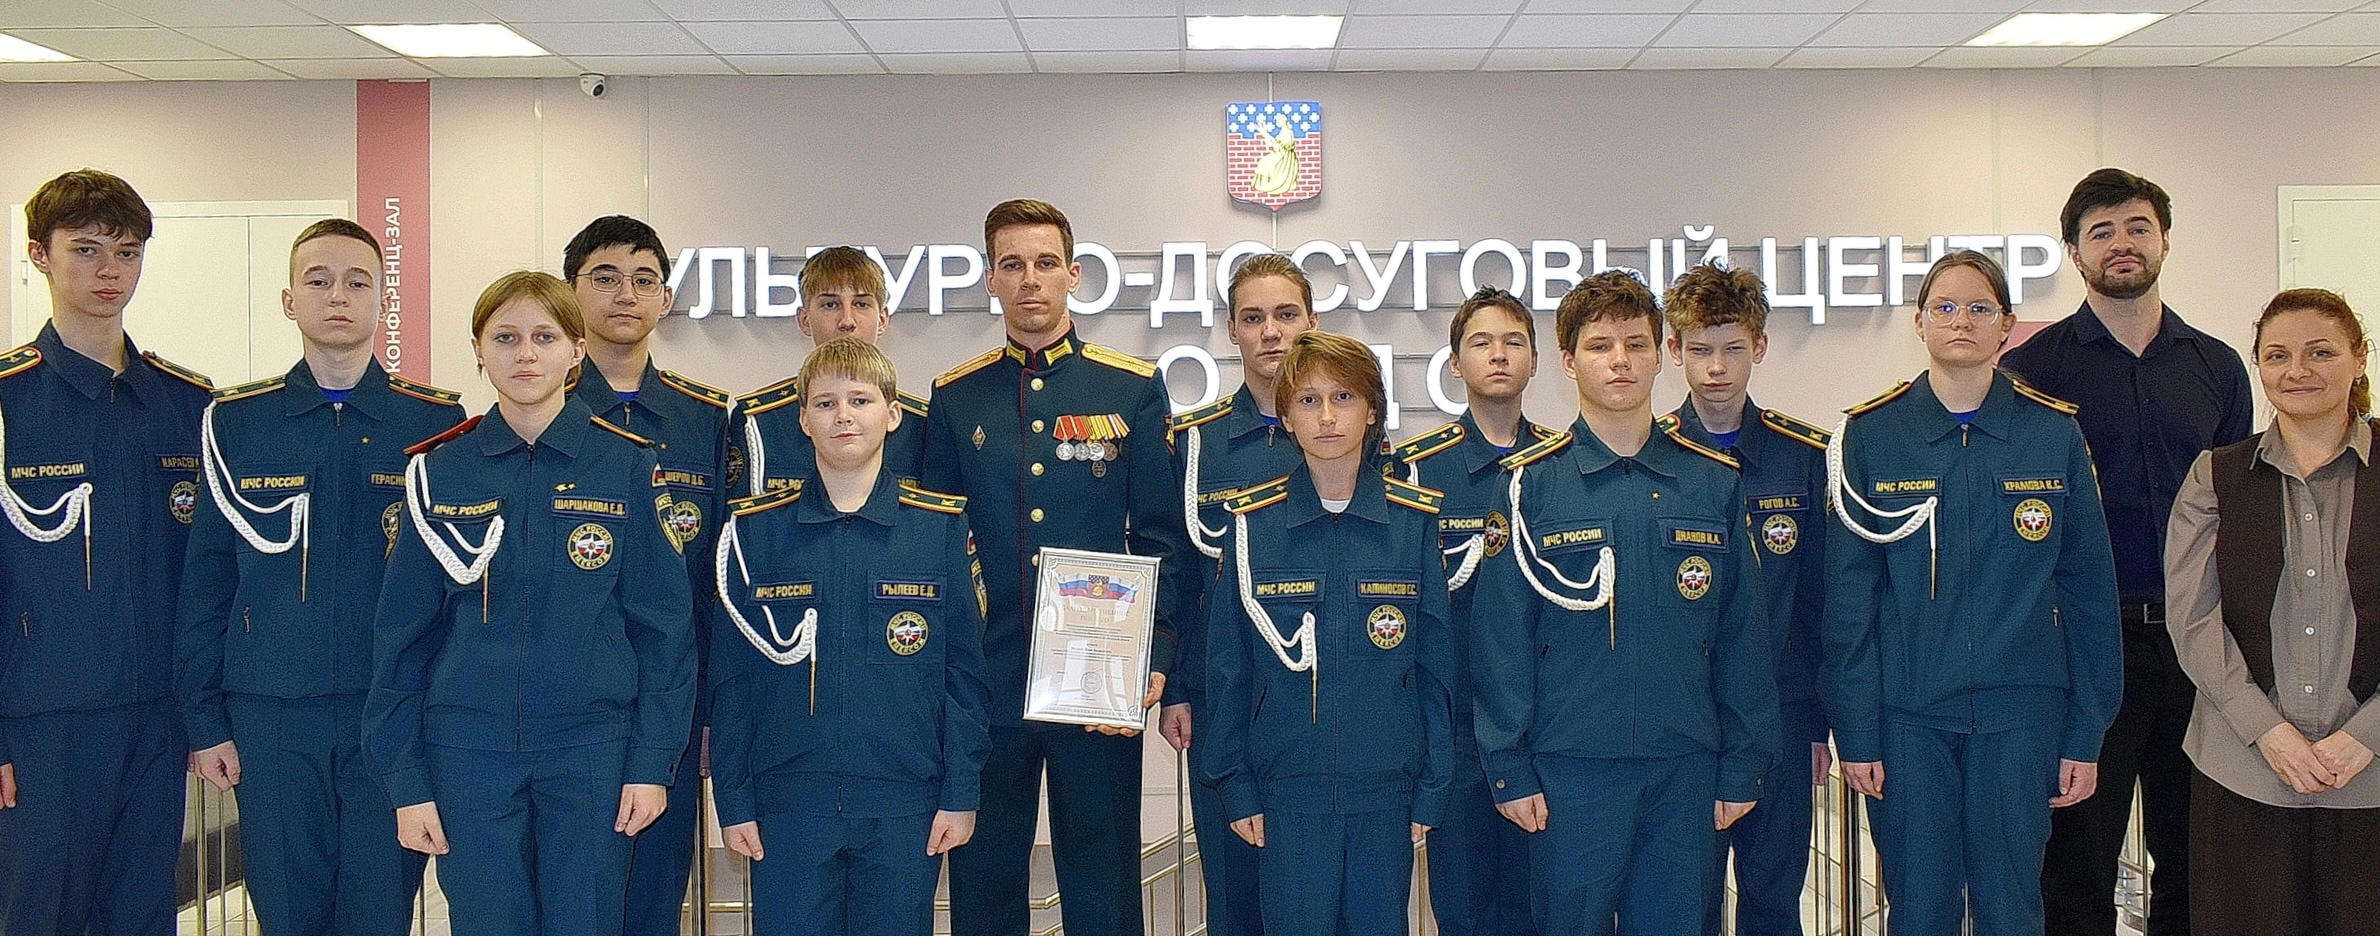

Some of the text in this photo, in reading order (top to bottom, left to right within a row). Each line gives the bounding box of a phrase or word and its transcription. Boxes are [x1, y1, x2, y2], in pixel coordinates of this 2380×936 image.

[385, 198, 403, 374] КОНФЕРЕНЦ-ЗАЛ
[11, 462, 85, 479] МЧС РОССИИ
[240, 475, 305, 490] МЧС РОССИИ
[767, 477, 787, 489] МЧС
[1875, 479, 1936, 493] МЧС РОССИИ
[432, 501, 499, 515] МЧС РОССИИ
[1448, 518, 1484, 529] РОССИИ
[1543, 528, 1602, 547] МЧС РОССИИ
[755, 584, 813, 598] МЧС РОССИИ
[882, 583, 919, 596] РЫЛЕЕВ
[1256, 581, 1316, 596] МЧС РОССИИ
